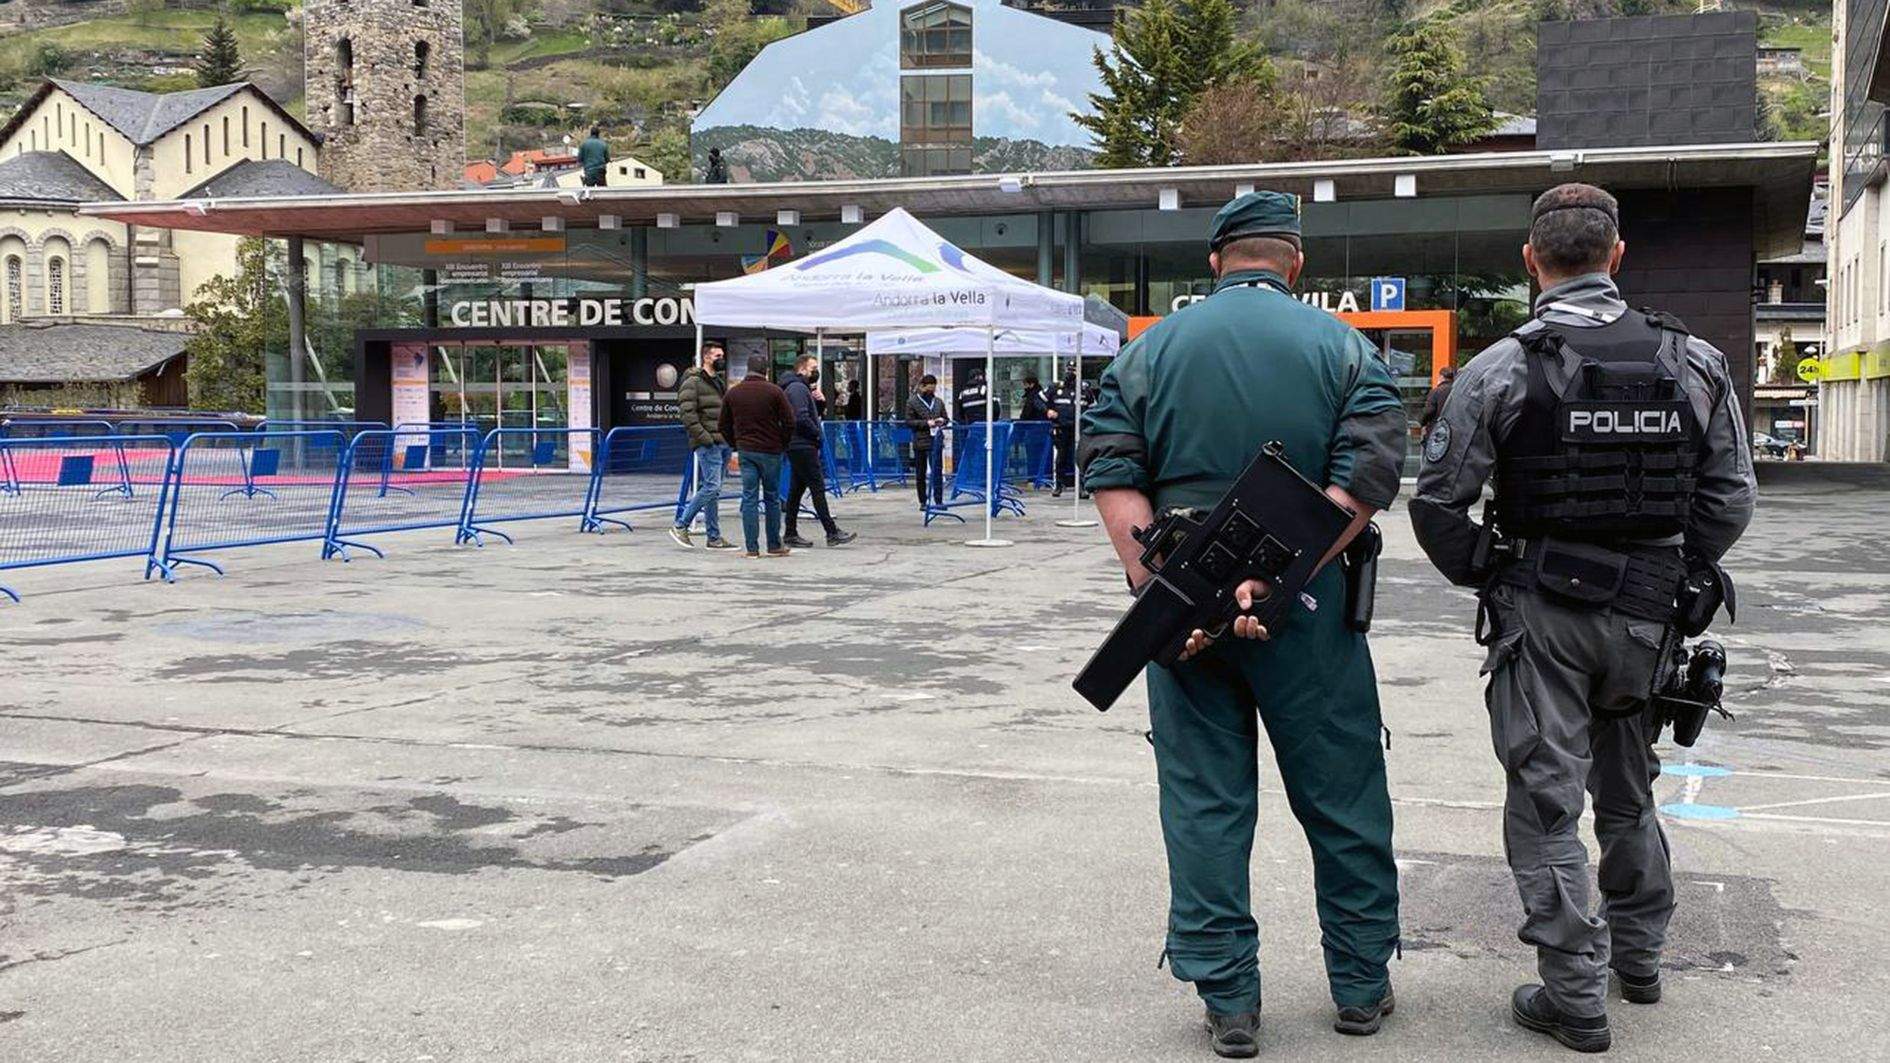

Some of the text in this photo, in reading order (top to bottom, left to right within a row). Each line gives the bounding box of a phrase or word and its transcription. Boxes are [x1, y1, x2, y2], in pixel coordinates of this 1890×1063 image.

[873, 290, 986, 307] Andorra la Vella
[1381, 284, 1398, 308] P
[451, 300, 568, 327] CENTRE
[580, 299, 622, 326] DE
[1569, 410, 1682, 433] POLICIA
